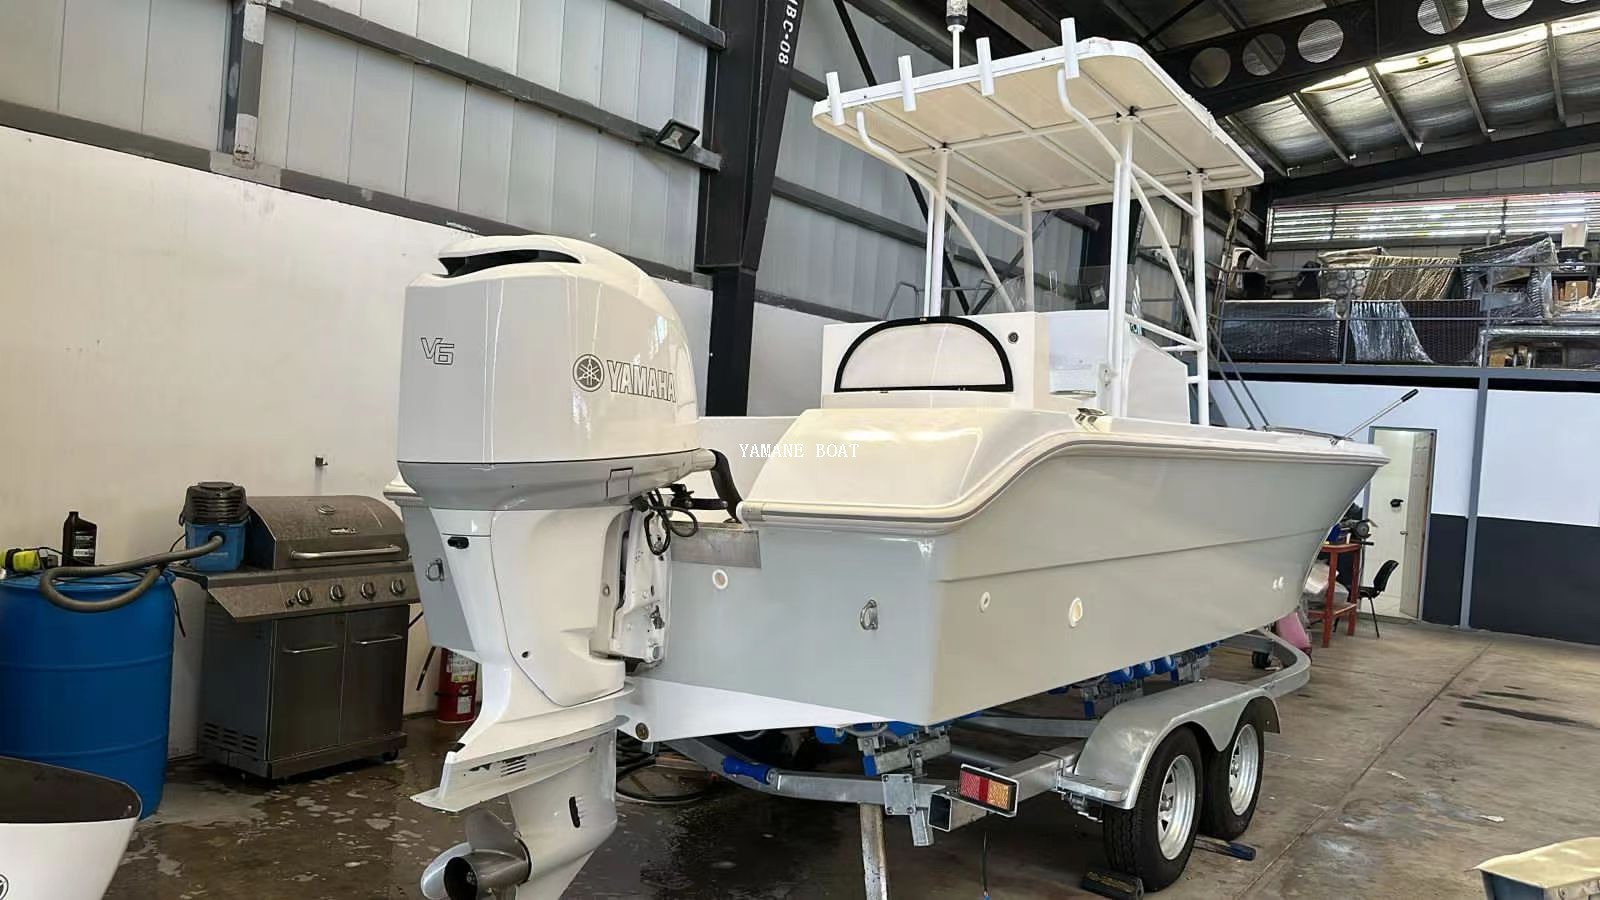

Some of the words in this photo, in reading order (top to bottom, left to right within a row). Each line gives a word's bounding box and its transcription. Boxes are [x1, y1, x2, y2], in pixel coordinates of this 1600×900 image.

[778, 0, 798, 64] BC-08
[420, 337, 455, 365] V6
[606, 359, 676, 403] YAMAHA
